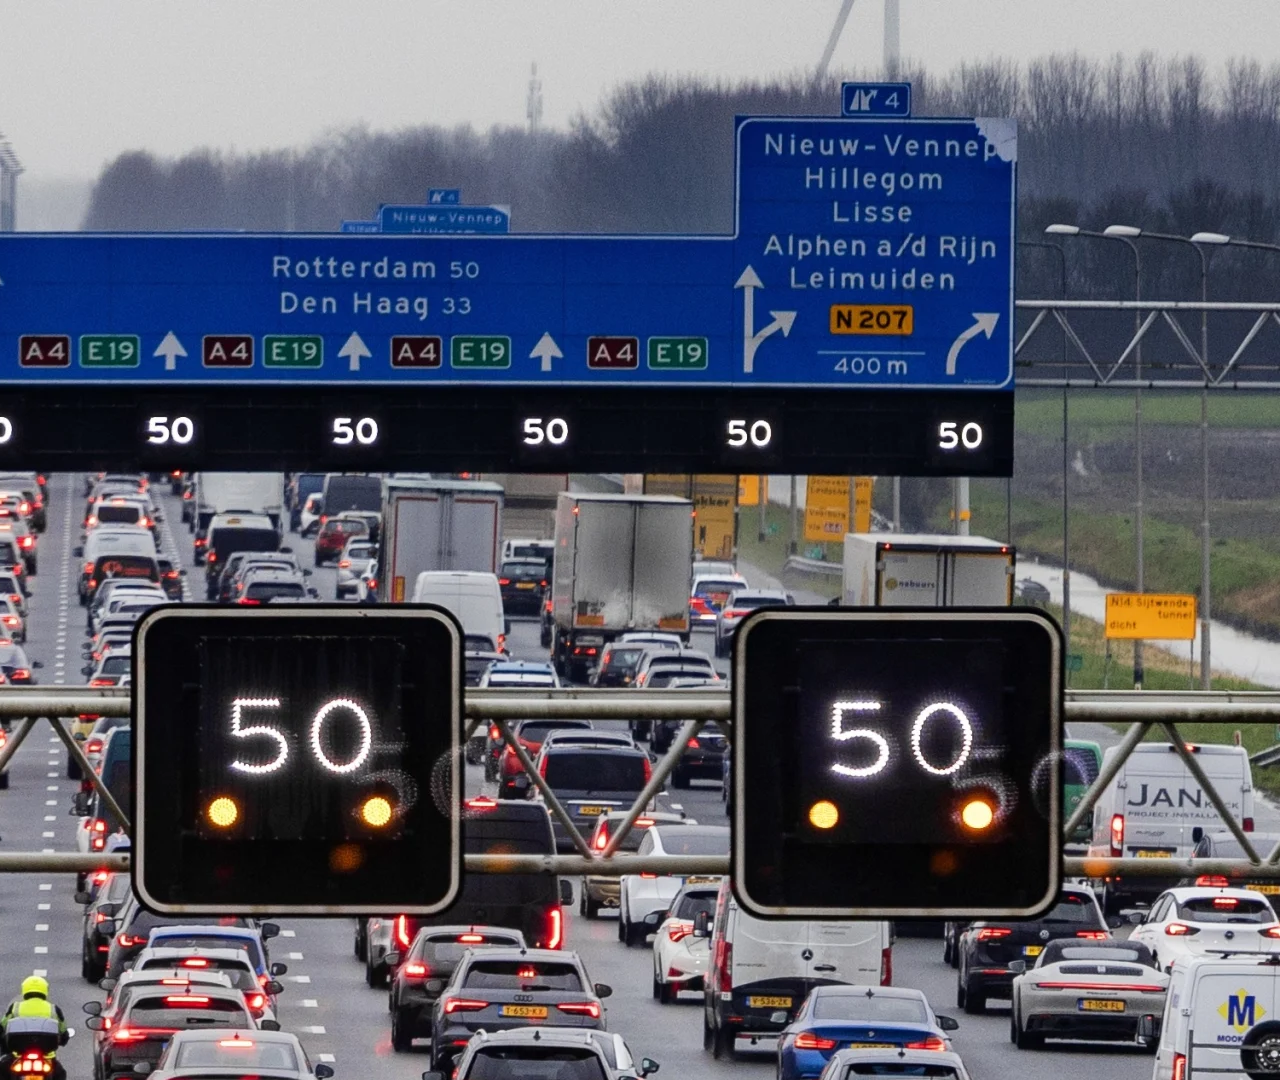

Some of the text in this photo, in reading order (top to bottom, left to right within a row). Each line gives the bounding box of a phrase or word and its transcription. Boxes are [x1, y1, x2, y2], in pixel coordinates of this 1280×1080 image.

[885, 92, 900, 109] 4
[764, 133, 998, 161] Nieuw-Vennep
[805, 167, 943, 195] Hillegom
[393, 211, 502, 225] Nieuw-Vennep
[833, 201, 912, 222] Lisse
[763, 233, 997, 264] Alphen a/d Rijn
[273, 255, 480, 279] Rotterdam 50
[790, 267, 956, 290] Leimuiden
[280, 292, 472, 321] Den Haag 33
[834, 357, 908, 375] 400 m
[147, 415, 195, 445] 50
[331, 416, 379, 445] 50
[523, 417, 569, 445] 50
[727, 419, 772, 447] 50
[938, 422, 983, 449] 50
[1109, 621, 1137, 630] dicht
[1158, 610, 1193, 620] tunnel
[231, 698, 371, 774] 50
[831, 700, 972, 776] 50
[1127, 784, 1202, 809] JAN
[1128, 811, 1169, 819] PROJECT
[1227, 995, 1255, 1027] M
